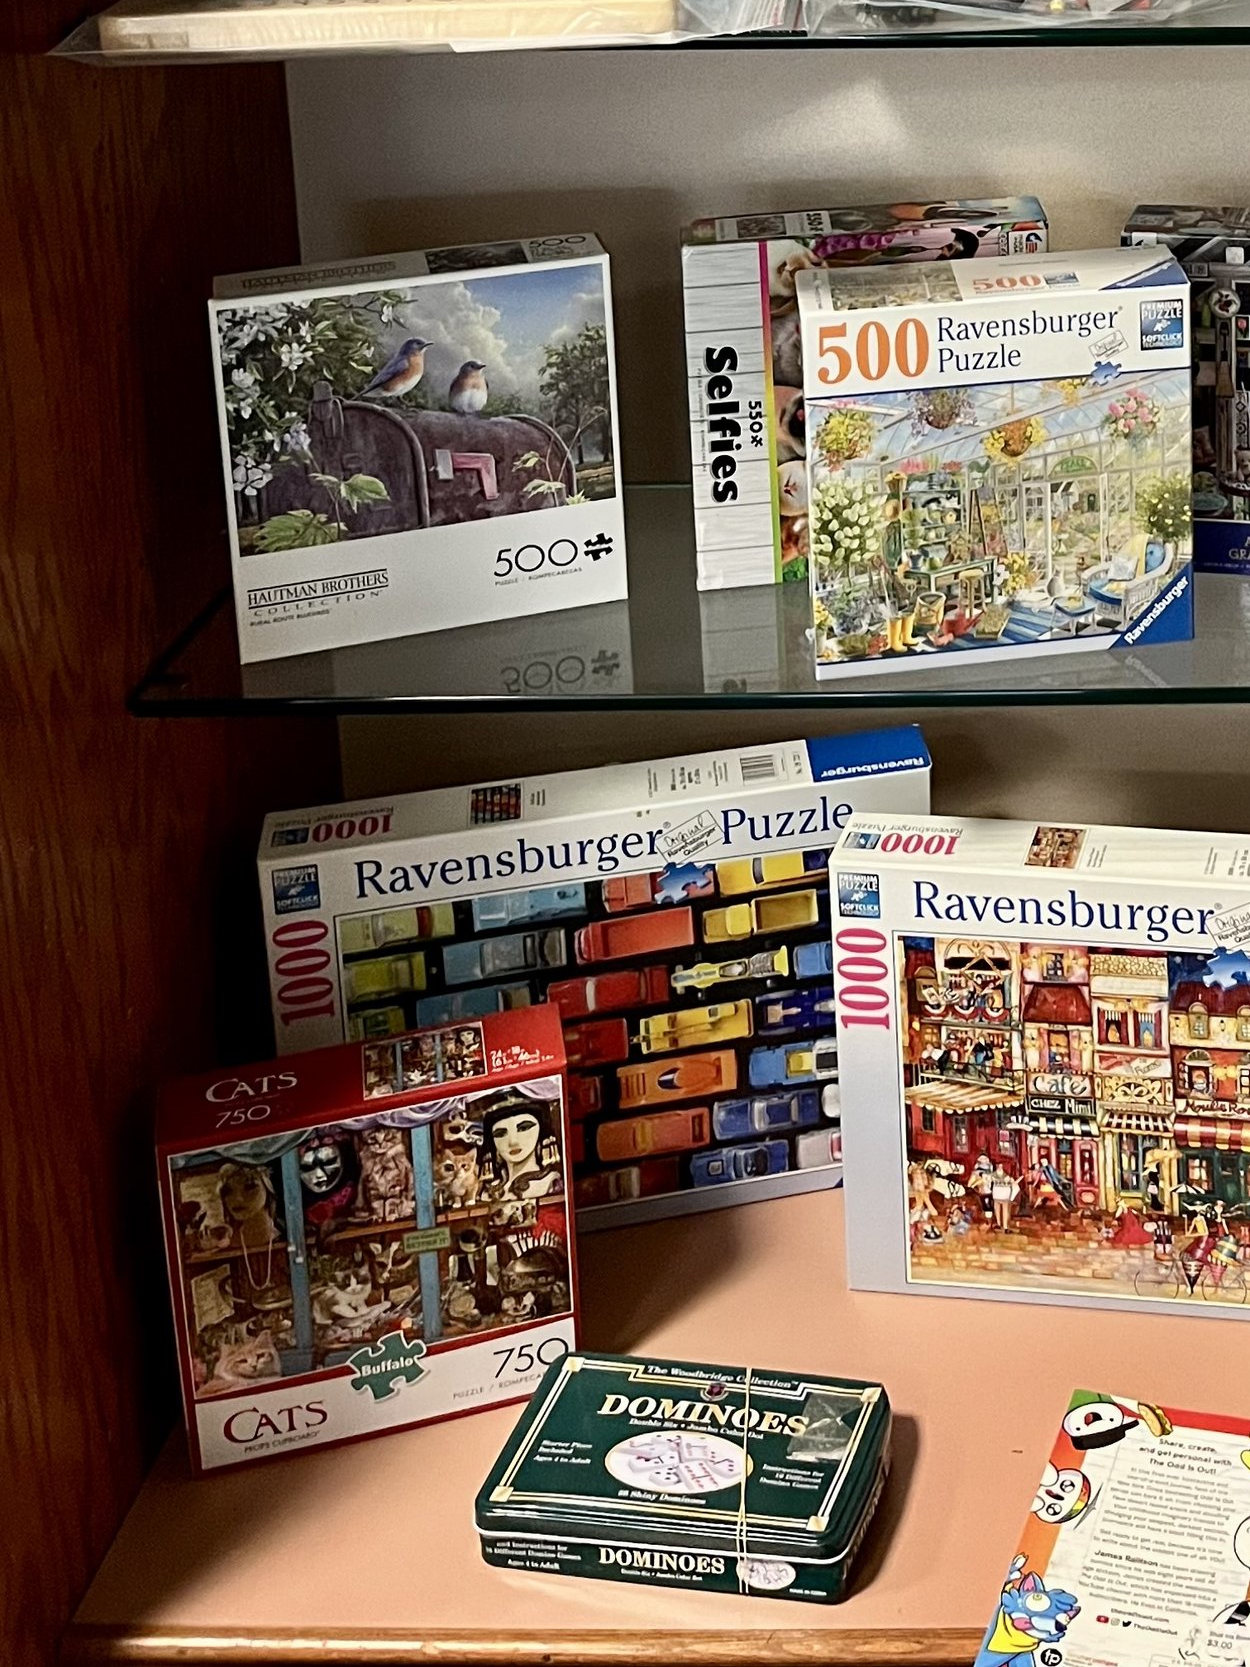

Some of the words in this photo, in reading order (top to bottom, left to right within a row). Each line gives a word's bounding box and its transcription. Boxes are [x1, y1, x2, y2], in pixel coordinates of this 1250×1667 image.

[1142, 309, 1182, 319] PUZZLE
[817, 318, 929, 385] 500
[937, 309, 1120, 343] Ravensburger
[1142, 333, 1182, 342] SOFTCLICK
[938, 346, 1022, 374] Puzzle
[705, 346, 739, 504] Selfies
[494, 538, 578, 577] 500
[248, 583, 318, 606] HAUTMAN
[322, 571, 389, 595] BROTHERS
[254, 590, 378, 617] COLLECTION
[1123, 575, 1190, 646] Ravensburger
[819, 757, 925, 779] Ravensburger
[355, 824, 663, 898] Ravensburger
[720, 796, 854, 844] Puzzle
[881, 833, 961, 855] 1000
[275, 873, 317, 884] PUZZLE
[839, 875, 878, 883] PREMIUM
[839, 881, 878, 892] PUZZLE
[913, 881, 1214, 943] Ravensburger
[272, 920, 335, 1026] 1000
[836, 927, 890, 1029] 1000
[206, 1072, 298, 1104] CATS
[1032, 1074, 1087, 1096] Café
[216, 1104, 271, 1129] 750
[1031, 1099, 1061, 1111] CHEZ
[1065, 1099, 1093, 1115] Mimi
[362, 1355, 415, 1377] Buffalo
[493, 1337, 570, 1379] 750
[646, 1365, 668, 1375] The
[670, 1367, 734, 1382] Woodbridge
[736, 1374, 792, 1389] Collection
[223, 1401, 329, 1443] CATS
[597, 1393, 810, 1436] DOMINOES
[1157, 1450, 1172, 1459] get
[1174, 1452, 1212, 1464] personal
[1213, 1457, 1232, 1466] with
[1159, 1439, 1185, 1449] Share,
[1188, 1445, 1217, 1454] create,
[598, 1547, 725, 1576] DOMINOES
